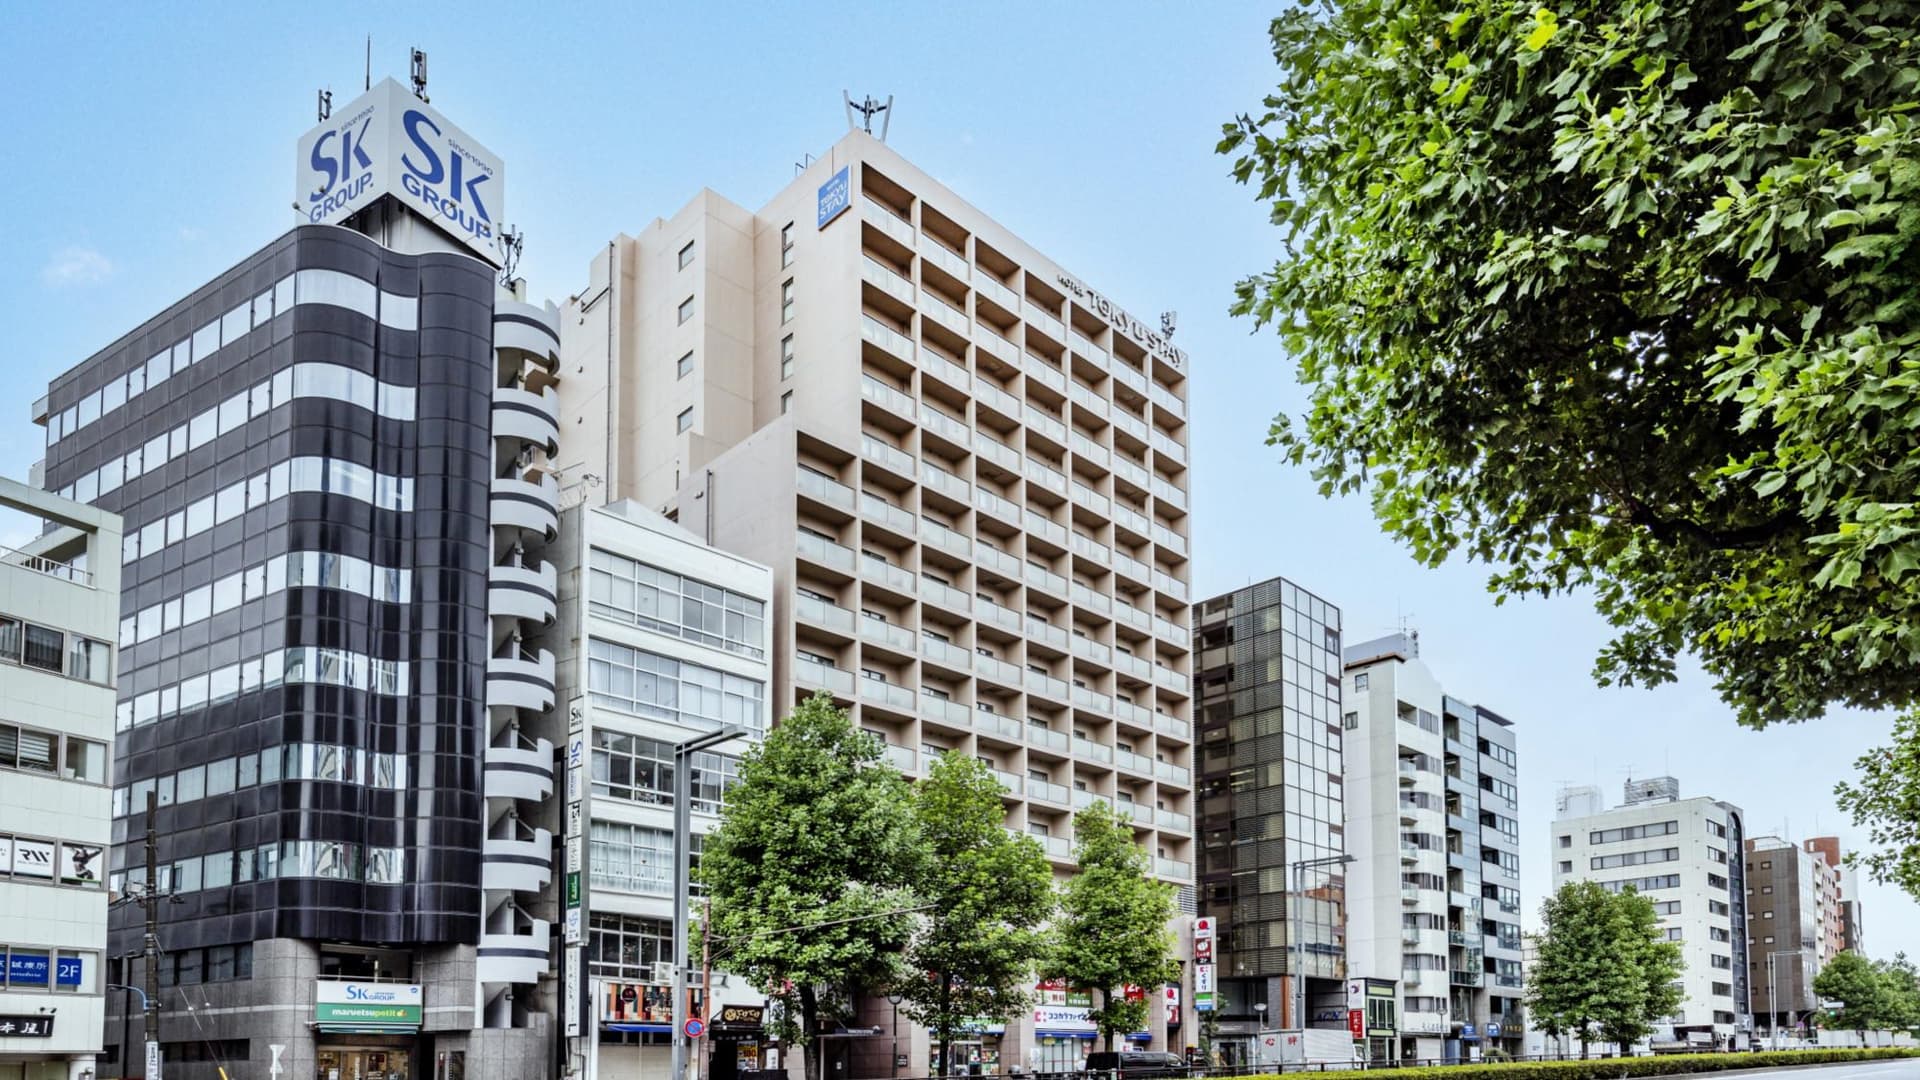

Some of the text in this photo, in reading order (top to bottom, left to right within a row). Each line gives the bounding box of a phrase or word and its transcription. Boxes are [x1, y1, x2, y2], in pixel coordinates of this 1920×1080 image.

[309, 117, 373, 203] SK
[401, 109, 492, 224] SK
[1087, 289, 1145, 342] TOKYU
[1147, 332, 1181, 368] STAY
[570, 707, 583, 721] SK
[570, 740, 582, 767] SK
[59, 964, 80, 979] 2F
[346, 984, 369, 1001] SK
